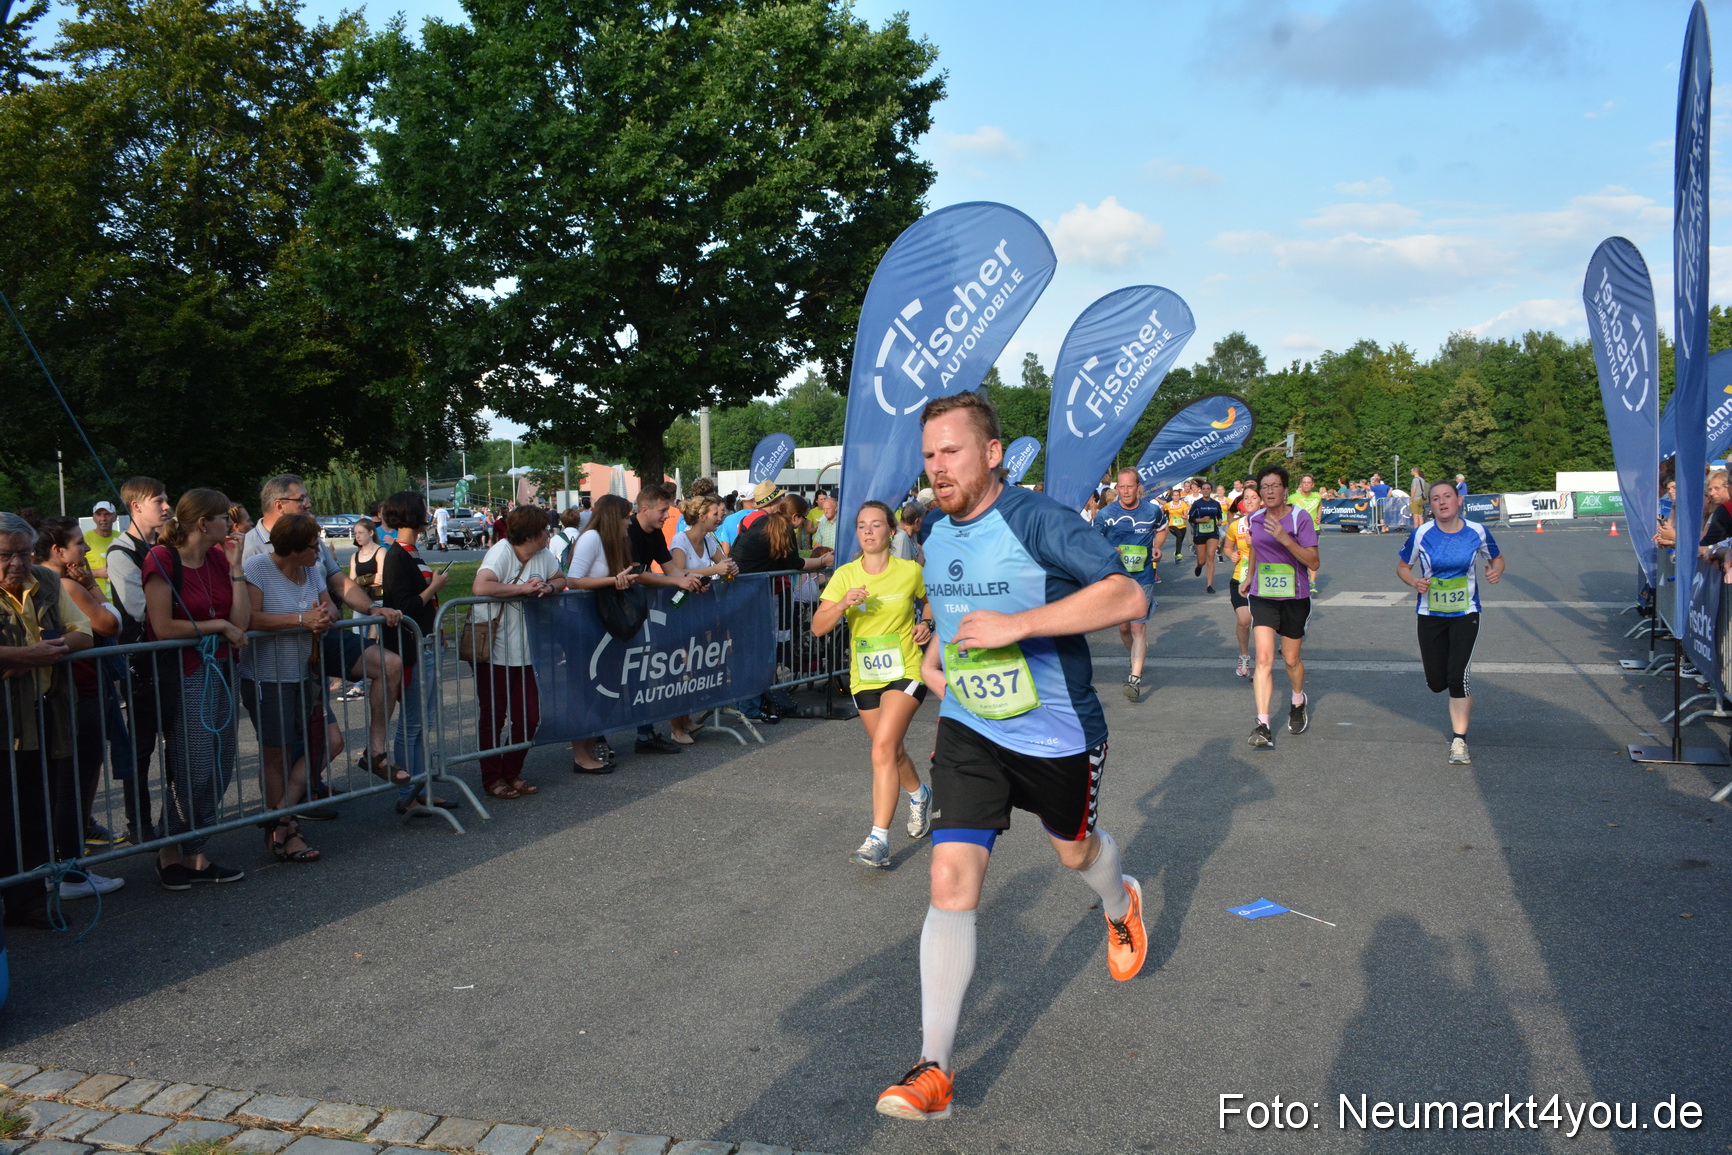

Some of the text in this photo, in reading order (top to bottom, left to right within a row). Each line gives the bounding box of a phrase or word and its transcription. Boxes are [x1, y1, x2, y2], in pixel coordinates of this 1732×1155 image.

[901, 238, 1012, 390] Fischer
[939, 268, 1025, 389] AUTOMOBILE
[1085, 309, 1162, 419] Fischer
[1113, 329, 1173, 417] AUTOMOBILE
[1190, 445, 1211, 460] Druck
[1223, 424, 1249, 443] Medien
[1708, 421, 1732, 441] Druck
[760, 440, 786, 477] Fischer
[1011, 442, 1033, 473] Fischer
[1137, 430, 1220, 481] Frischmann
[1124, 556, 1141, 565] 942
[925, 581, 1010, 597] CHABMÜLLER
[1265, 577, 1287, 588] 325
[1433, 591, 1465, 603] 1132
[944, 603, 970, 613] TEAM
[621, 636, 732, 685] Fischer
[863, 654, 893, 670] 640
[632, 672, 724, 706] AUTOMOBILE
[956, 668, 1019, 699] 1337
